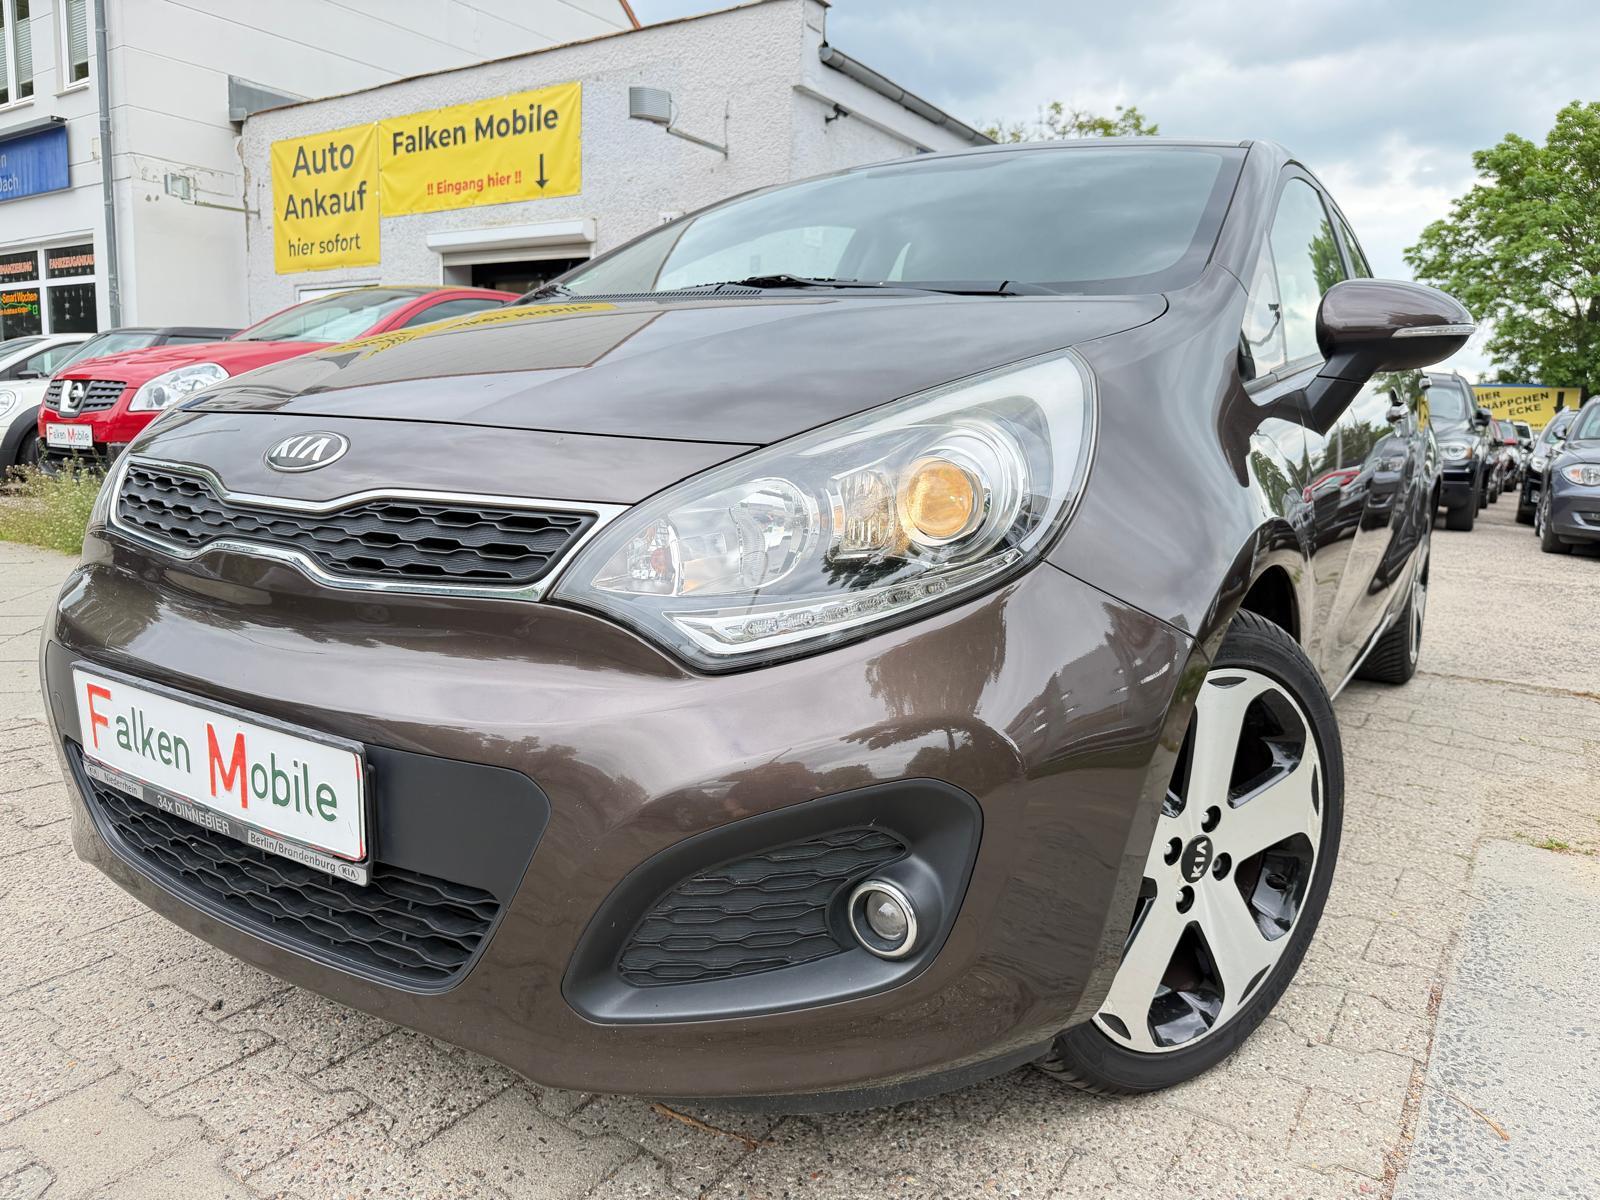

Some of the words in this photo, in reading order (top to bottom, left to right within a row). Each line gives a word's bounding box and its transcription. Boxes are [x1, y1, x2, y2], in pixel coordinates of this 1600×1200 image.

[392, 125, 466, 156] Falken
[475, 104, 559, 142] Mobile
[292, 143, 354, 178] Auto
[284, 181, 367, 221] Ankauf
[437, 175, 483, 196] Eingang
[488, 172, 511, 188] hier
[288, 238, 315, 257] hier
[319, 232, 361, 254] sofort
[1508, 403, 1542, 416] ECKE
[271, 436, 332, 461] KIA
[86, 683, 191, 773] Falken
[206, 722, 338, 822] Mobile
[104, 772, 138, 794] Niederrhein
[175, 802, 230, 834] DINNEBIER
[250, 832, 336, 874] Berlin/Brandenburg
[341, 866, 356, 878] KIA
[1191, 840, 1207, 878] KIA
